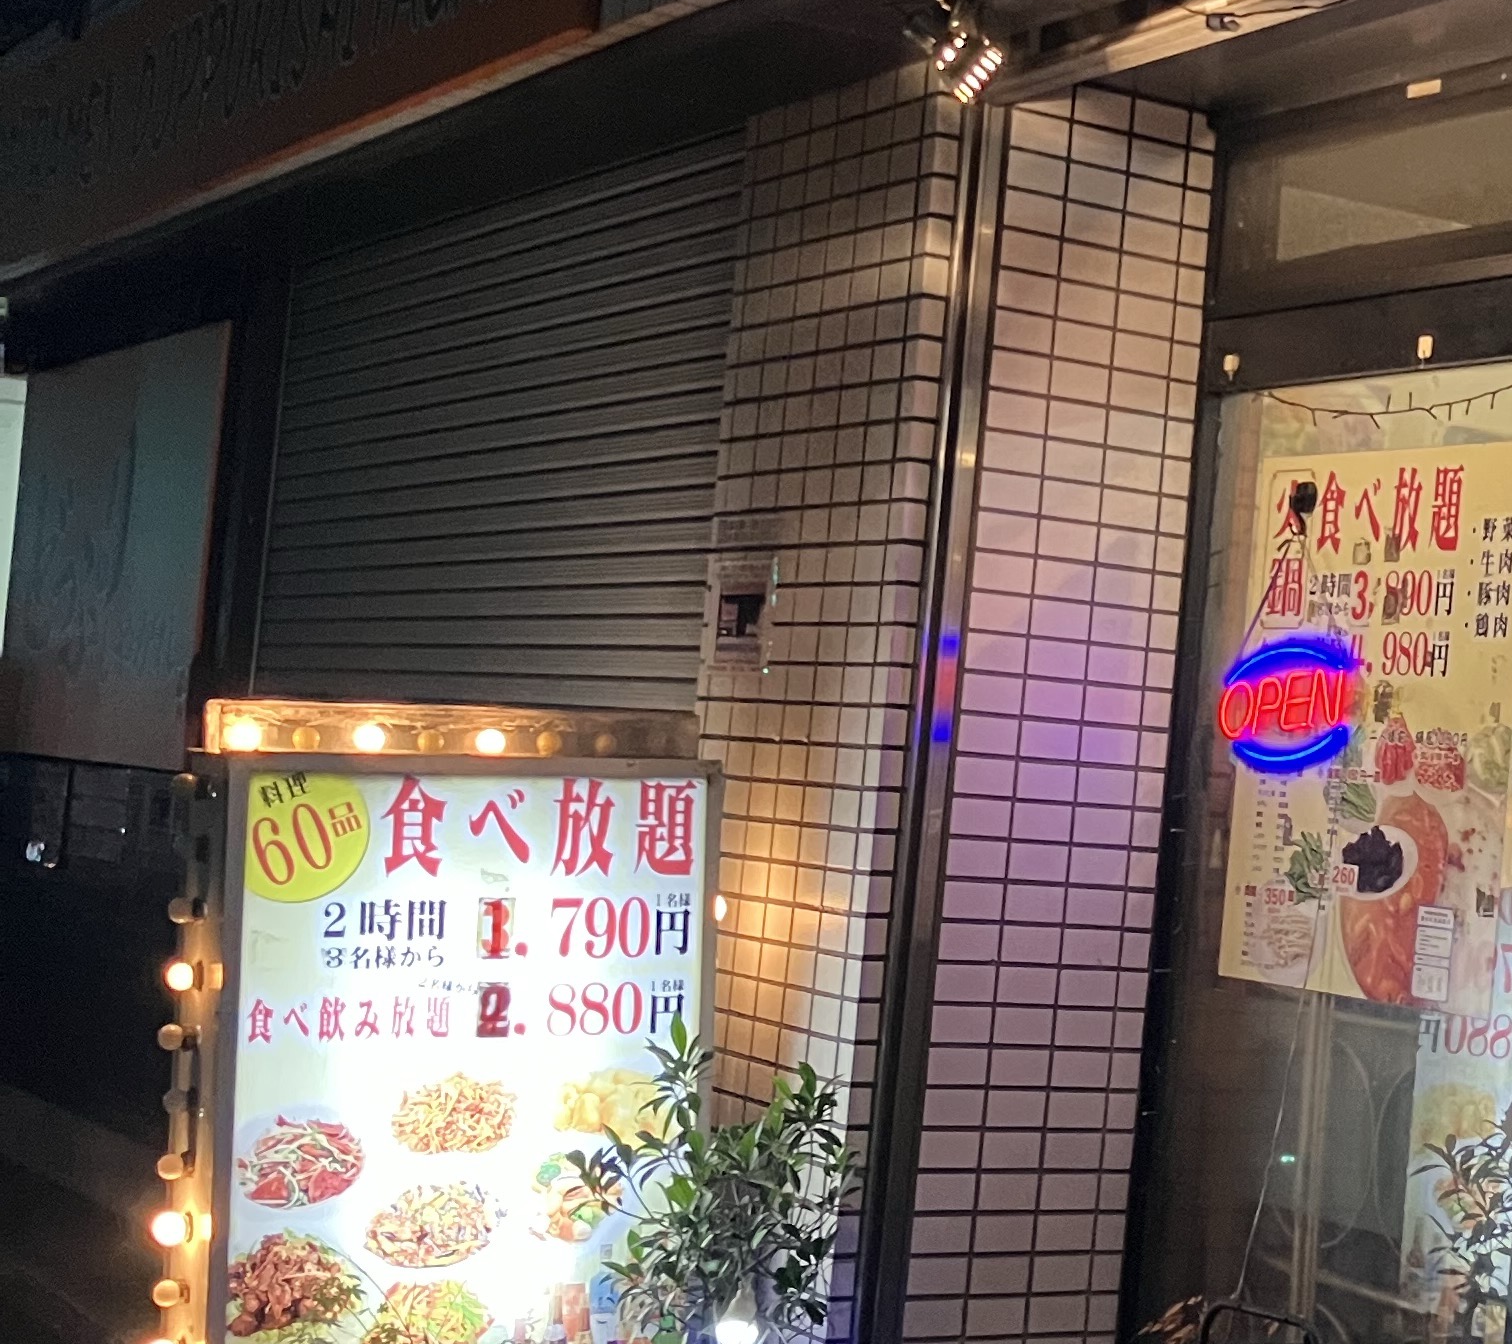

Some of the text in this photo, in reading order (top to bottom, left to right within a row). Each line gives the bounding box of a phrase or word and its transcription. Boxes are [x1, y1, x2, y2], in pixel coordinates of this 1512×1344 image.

[1316, 464, 1465, 555] 食べ放題
[1219, 668, 1345, 740] OPEN
[260, 771, 309, 808] 料理
[252, 801, 364, 886] 60品
[380, 773, 698, 878] 食べ放題
[323, 899, 448, 942] 2時間
[323, 945, 446, 971] 3名様から
[247, 995, 451, 1045] 食べ飲み放題
